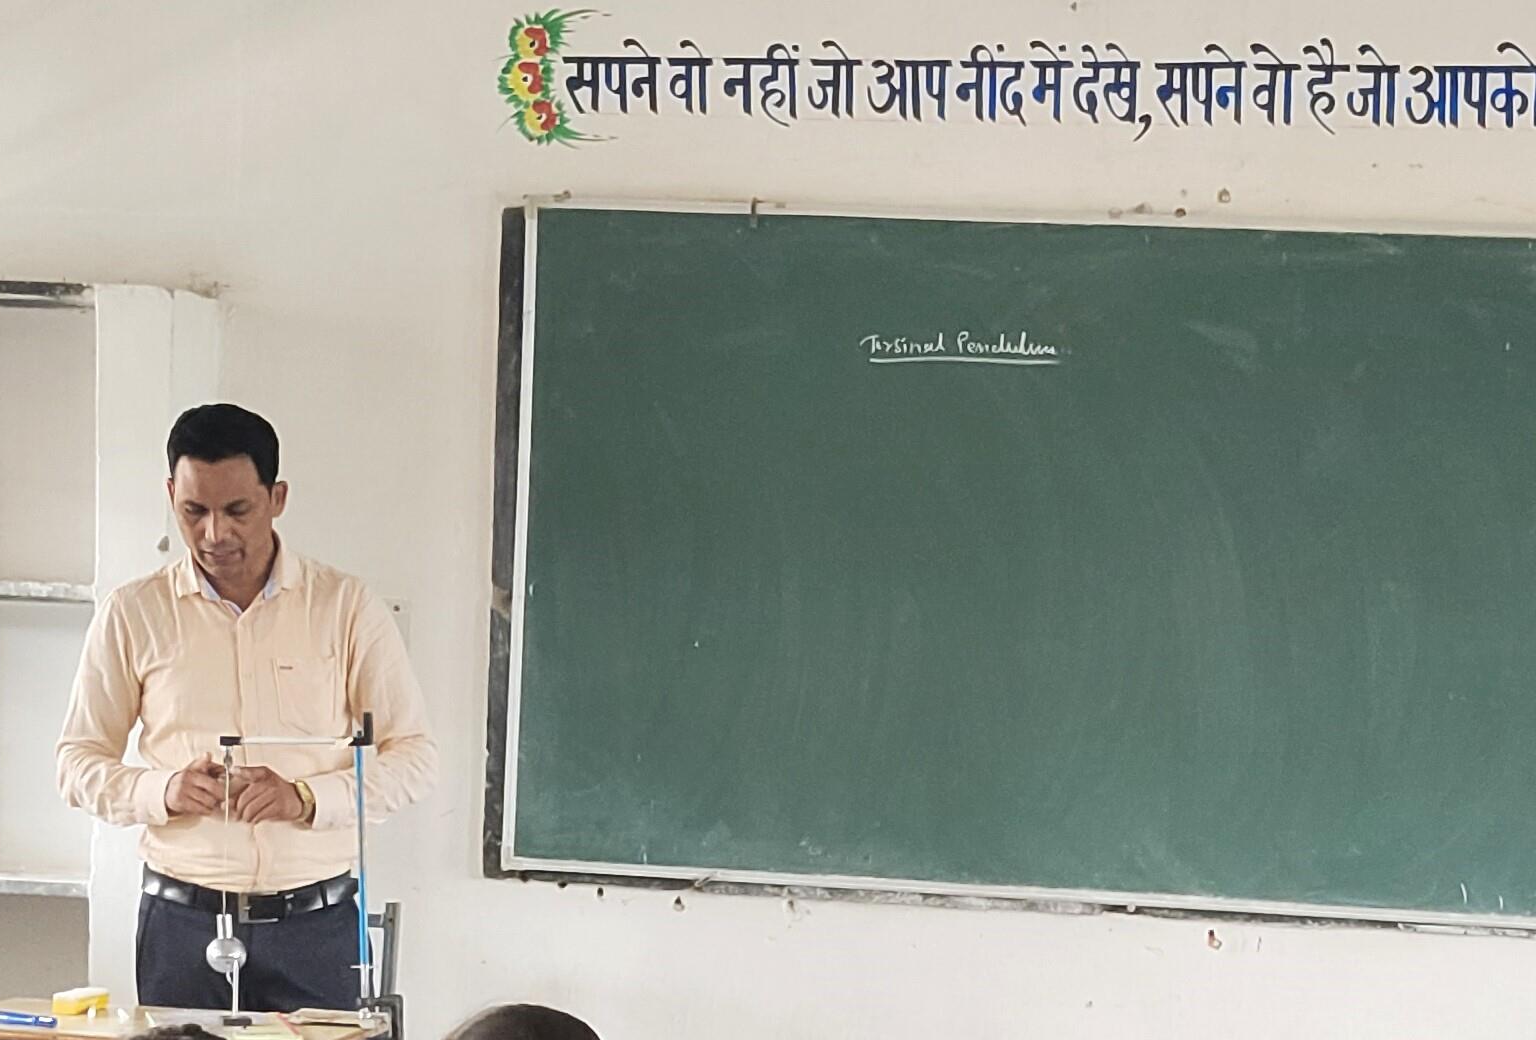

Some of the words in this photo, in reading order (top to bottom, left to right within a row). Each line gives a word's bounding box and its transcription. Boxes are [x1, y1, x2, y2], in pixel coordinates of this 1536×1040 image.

[562, 39, 661, 115] सपने
[666, 40, 714, 115] वो
[722, 43, 800, 127] नहीं
[807, 40, 863, 118] जो
[867, 59, 953, 122] आप
[955, 44, 1026, 127] नींद
[1028, 40, 1074, 123] में
[1154, 44, 1249, 127] सपने
[1249, 43, 1302, 125] वो
[1302, 37, 1351, 134] है
[1346, 44, 1402, 128] जो
